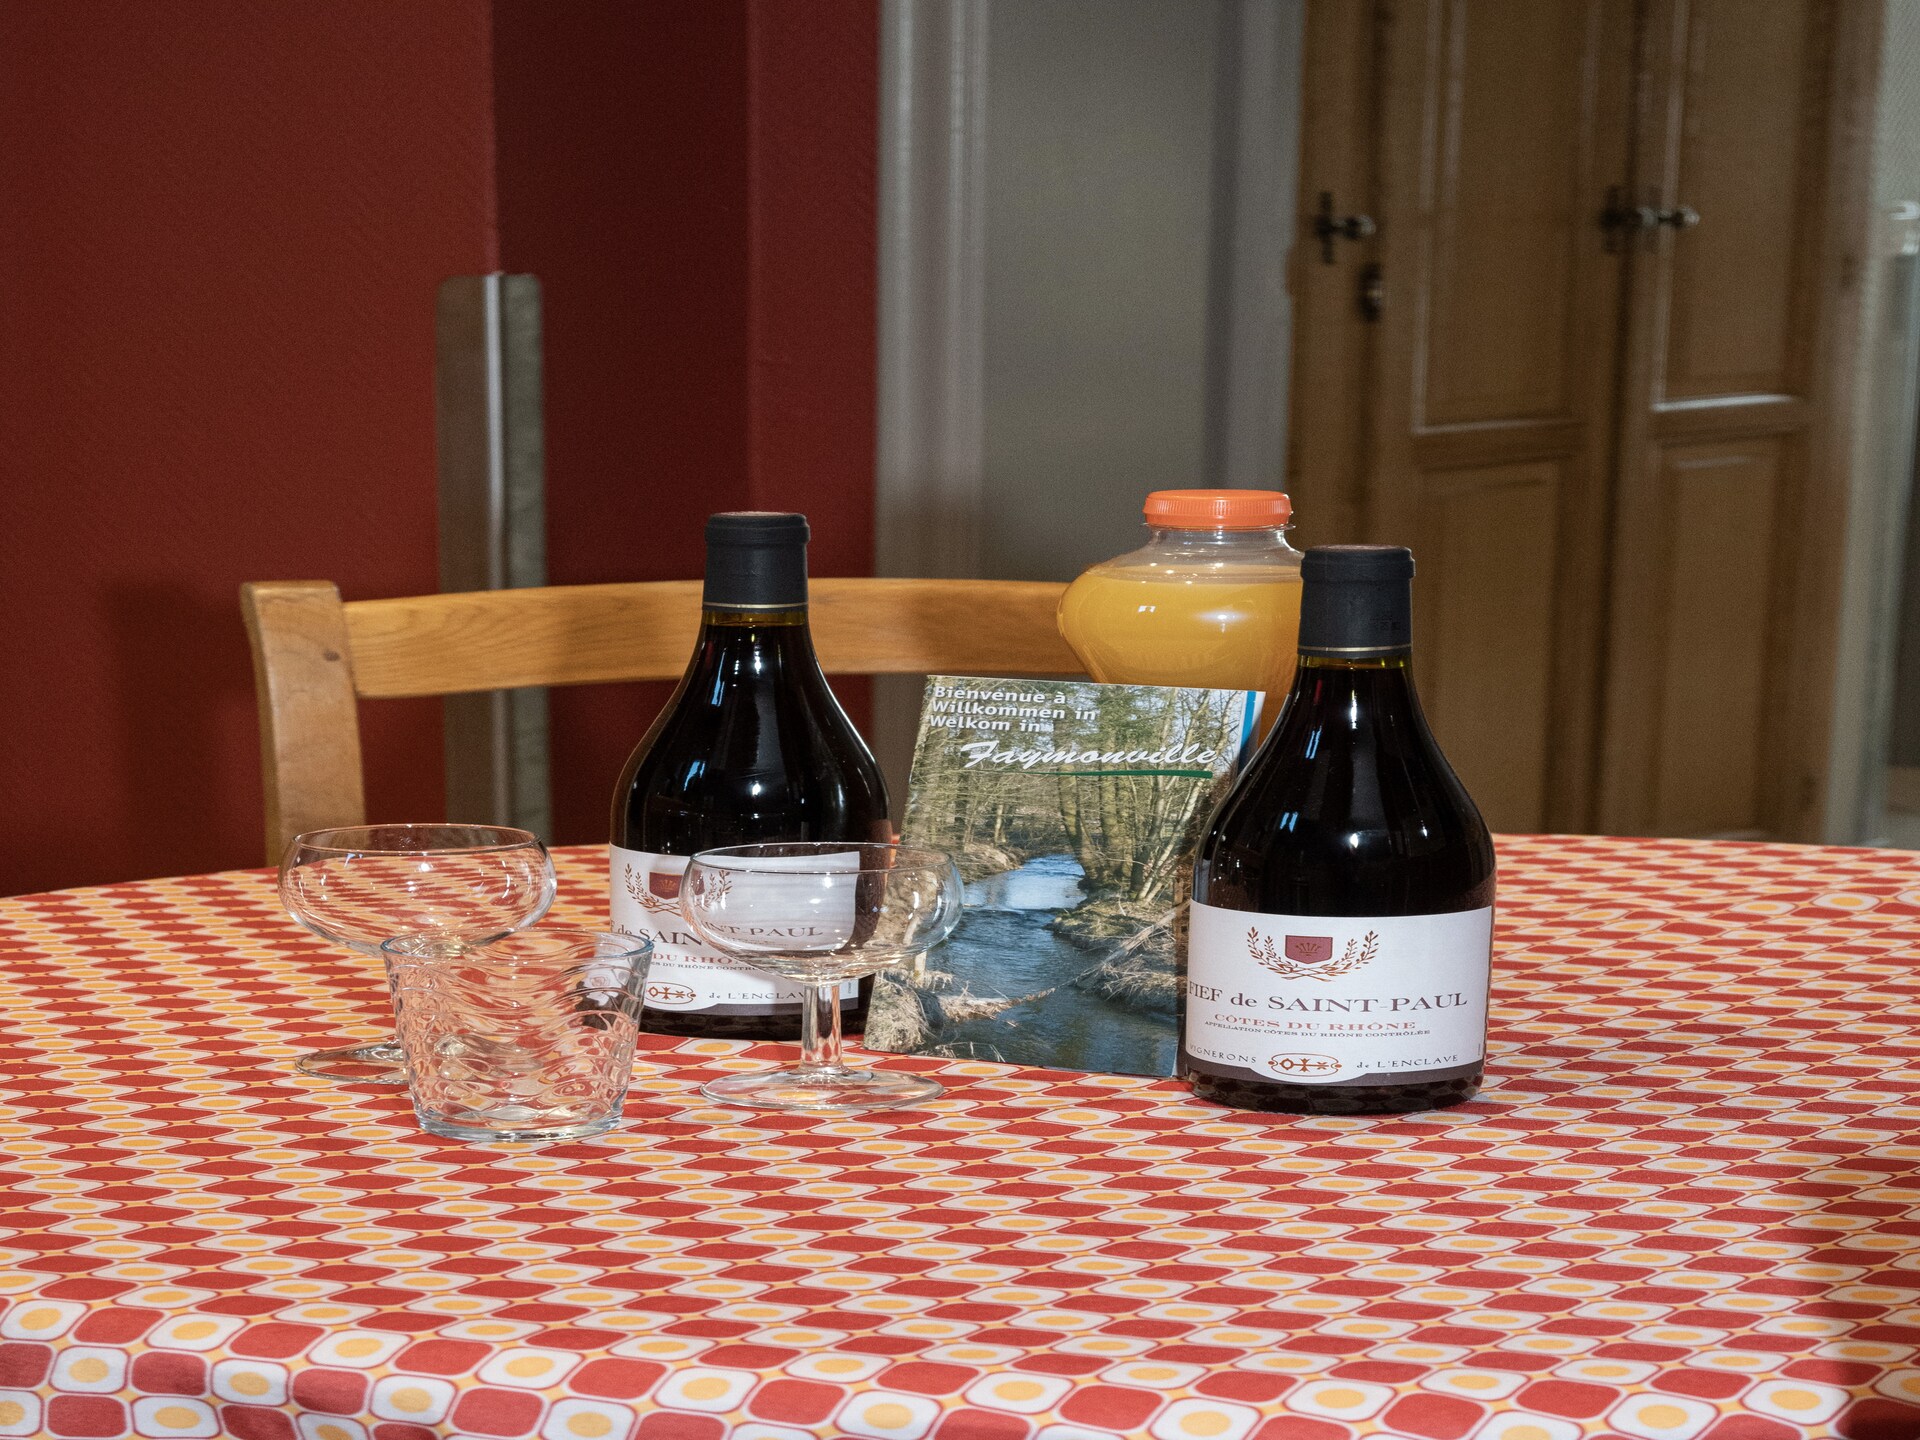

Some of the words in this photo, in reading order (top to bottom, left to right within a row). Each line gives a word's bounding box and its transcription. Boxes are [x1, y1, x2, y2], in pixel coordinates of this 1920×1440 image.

[934, 685, 1046, 703] Bienvenue
[1054, 692, 1066, 704] à
[931, 700, 1065, 719] Willkommen
[1075, 707, 1097, 720] in
[930, 715, 1011, 731] Welkom
[1020, 720, 1040, 732] in
[960, 739, 1219, 770] Faymonville
[652, 953, 678, 961] DU
[1189, 980, 1223, 1002] FIEF
[1230, 993, 1258, 1008] de
[1204, 1020, 1262, 1034] APPELLATION
[1214, 1013, 1281, 1028] CÔTES
[1287, 1021, 1320, 1031] DU
[1328, 1021, 1417, 1031] RHÔNE
[1189, 1043, 1257, 1064] VIGNERONS
[1356, 1061, 1370, 1069] de
[1377, 1054, 1459, 1069] L'ENCLAVE
